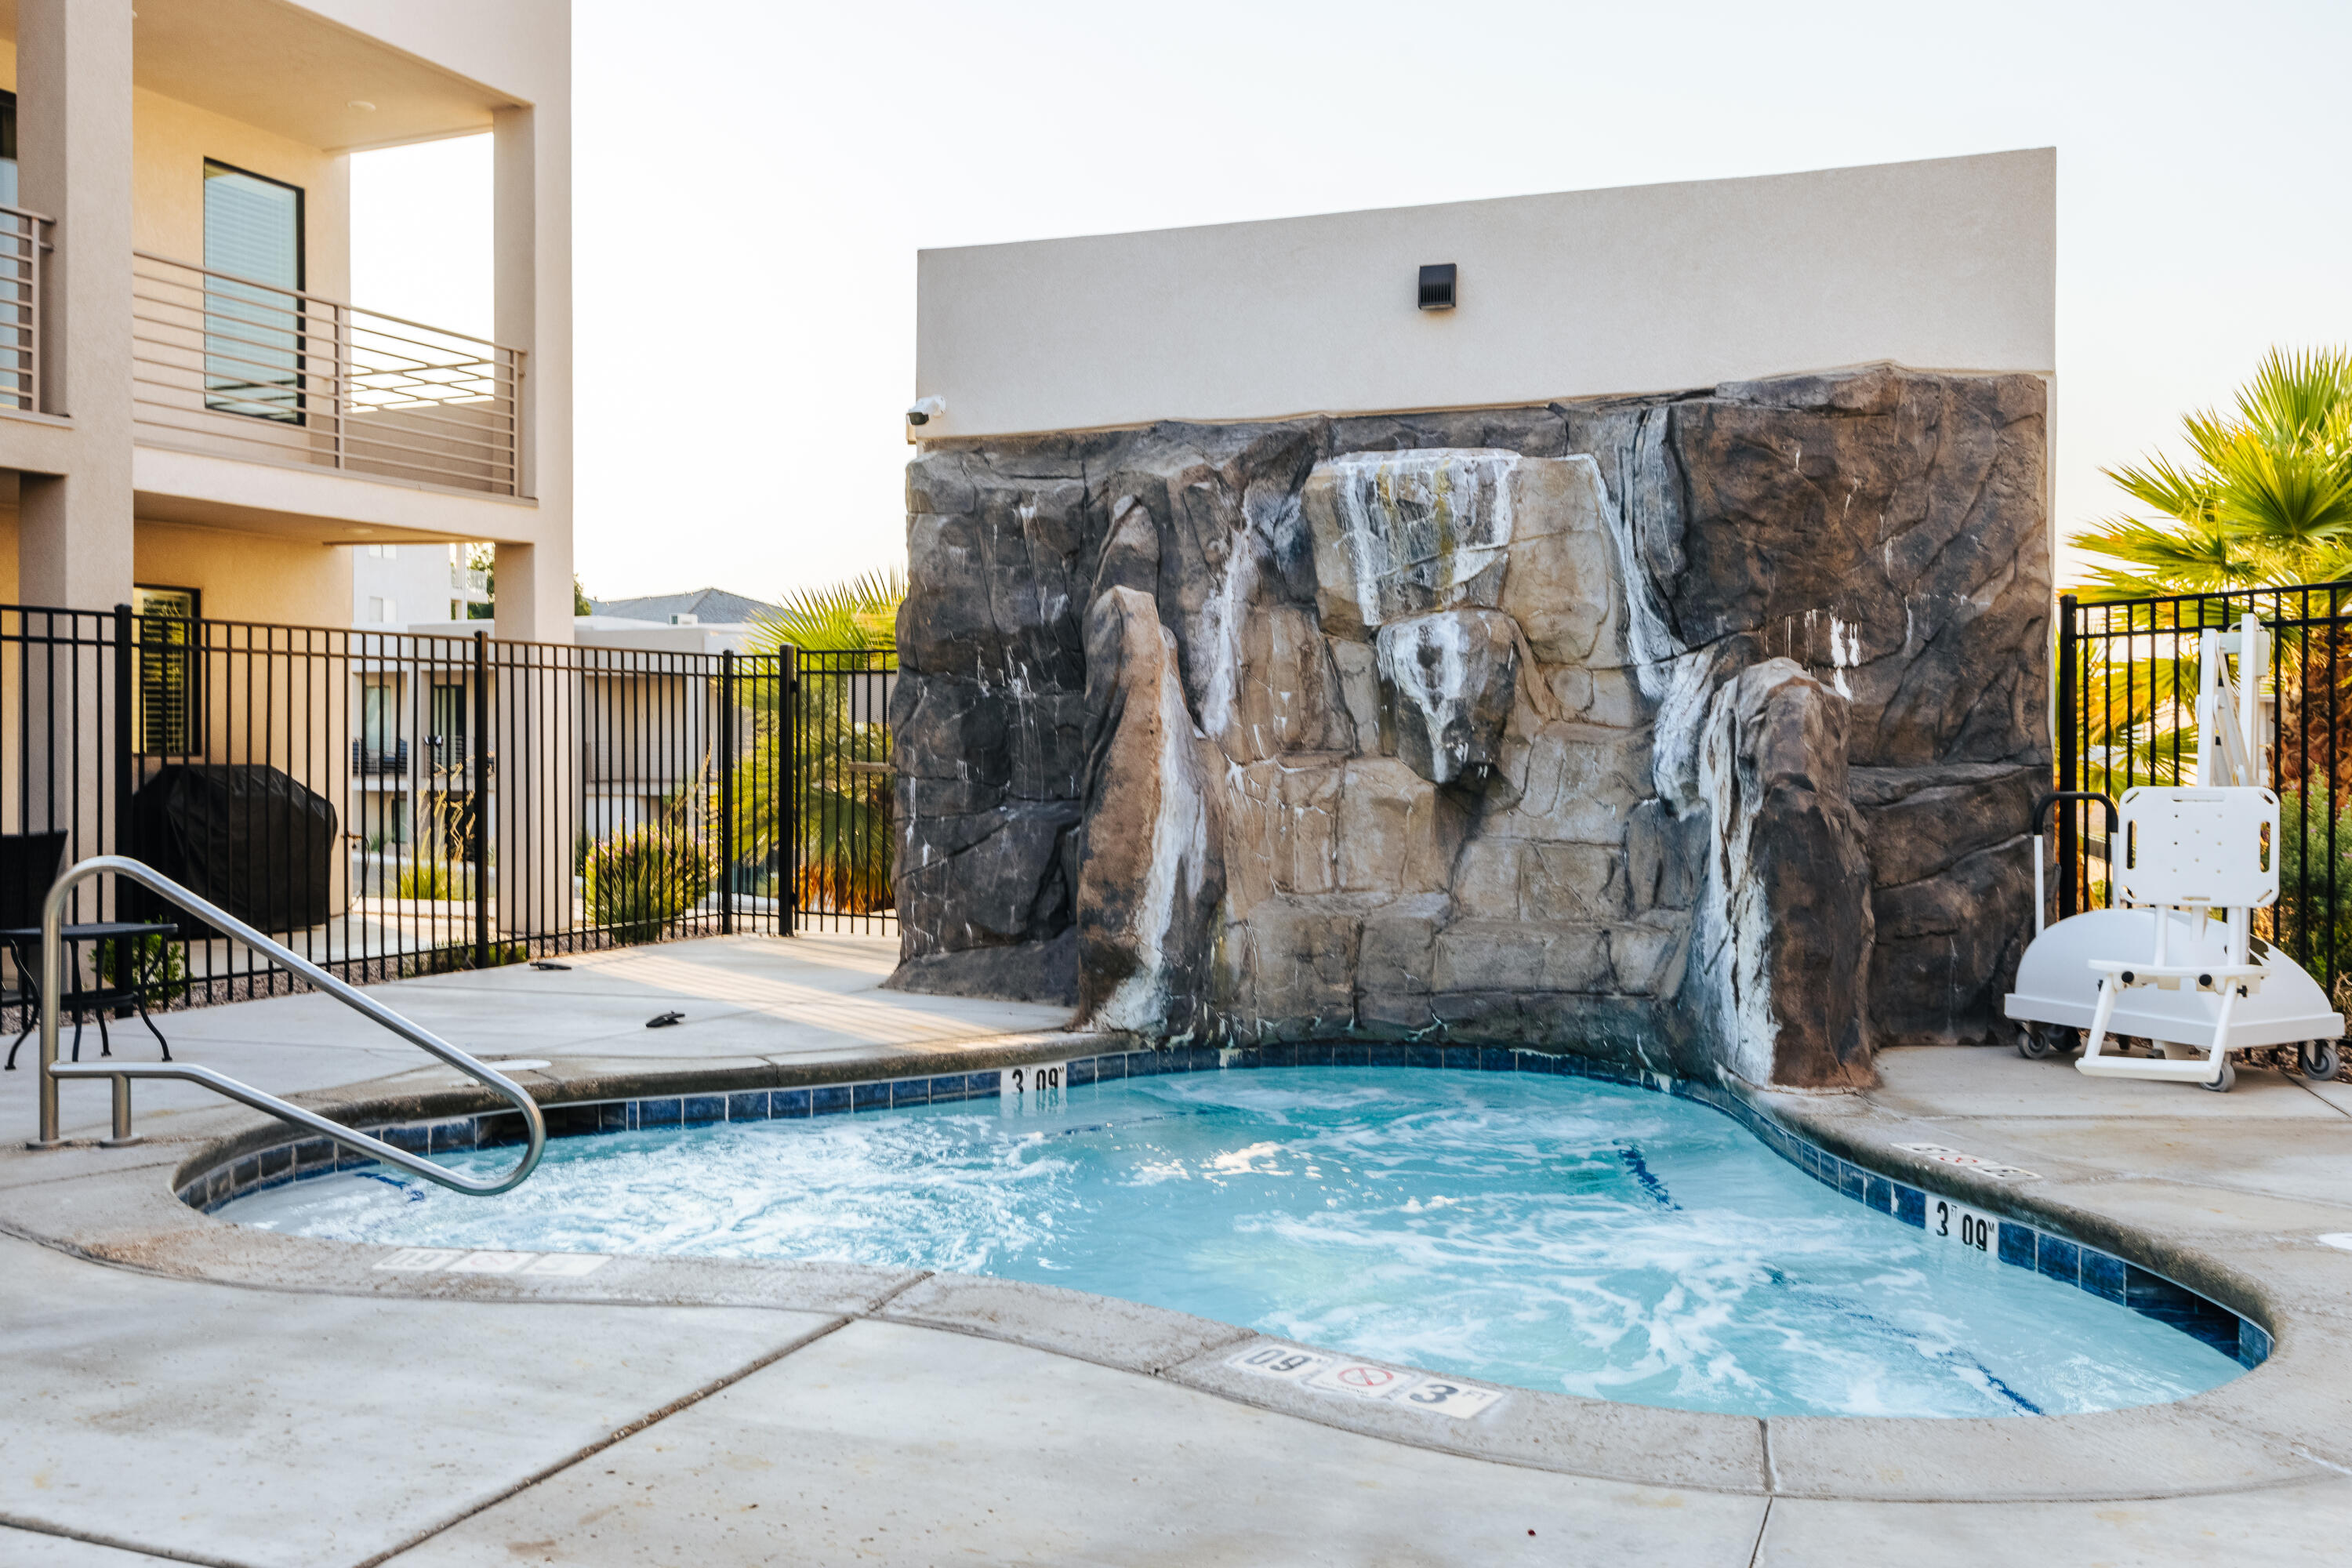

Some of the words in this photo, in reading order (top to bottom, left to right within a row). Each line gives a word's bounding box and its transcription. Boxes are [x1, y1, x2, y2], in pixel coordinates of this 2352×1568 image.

[1036, 1067, 1058, 1091] 09
[1936, 1201, 1948, 1237] 3
[1962, 1214, 1987, 1252] 09
[1243, 1348, 1313, 1371] 09
[1409, 1384, 1460, 1404] 3
